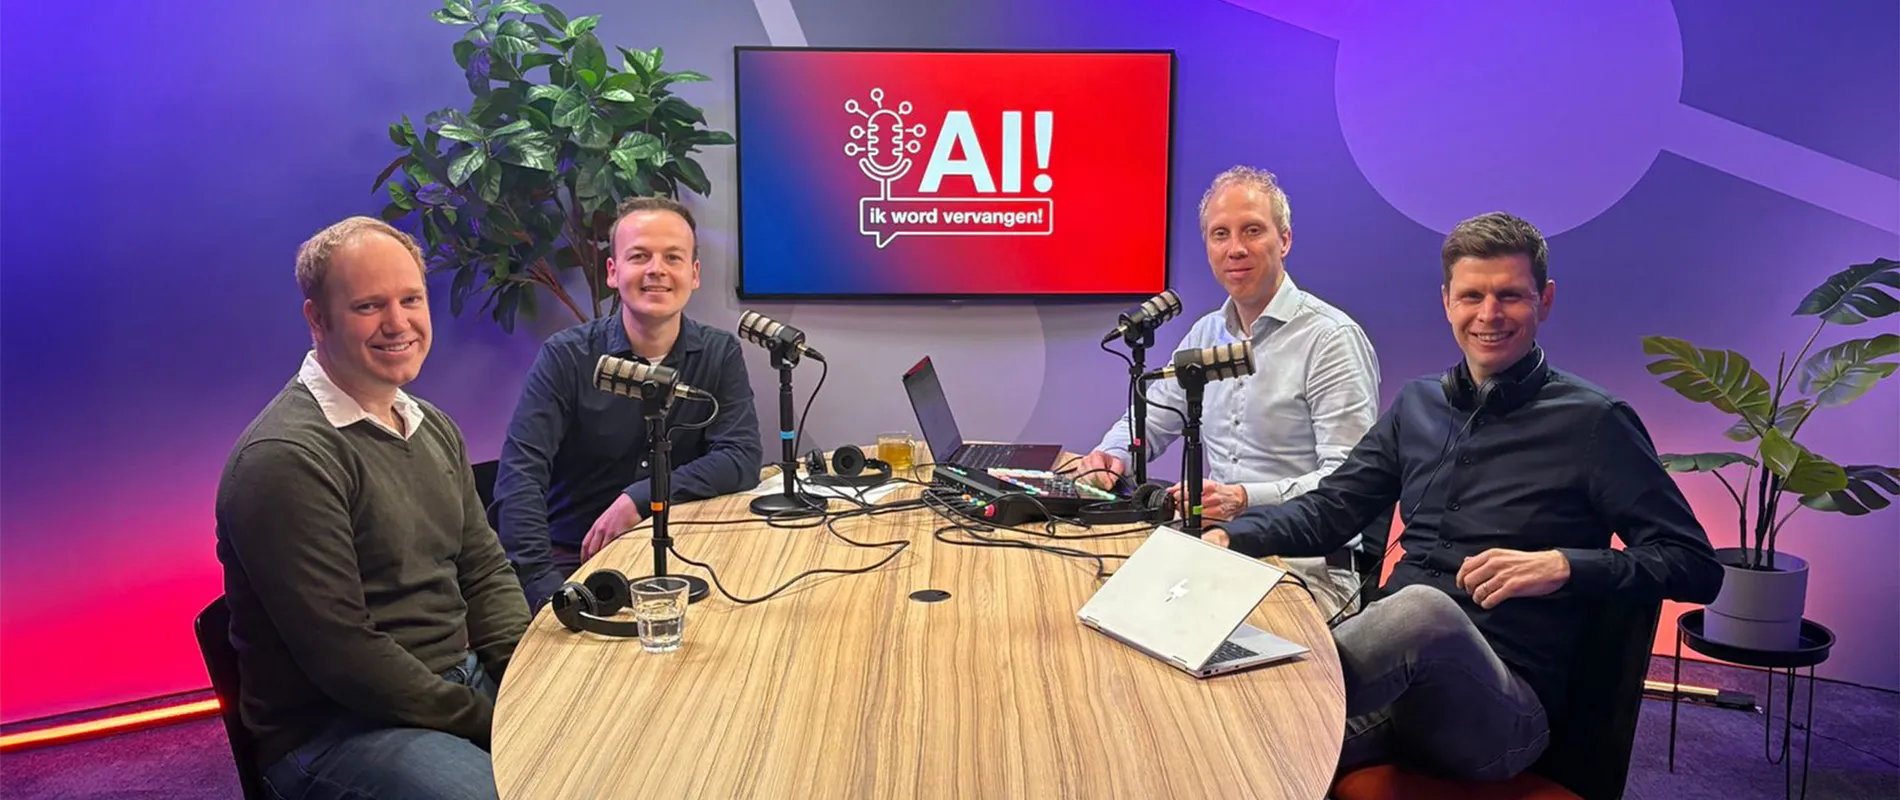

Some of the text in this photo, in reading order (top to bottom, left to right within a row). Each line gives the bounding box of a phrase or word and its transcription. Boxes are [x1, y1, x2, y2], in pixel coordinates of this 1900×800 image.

[917, 110, 1054, 193] AI!
[869, 207, 1044, 228] ik word vervangen!
